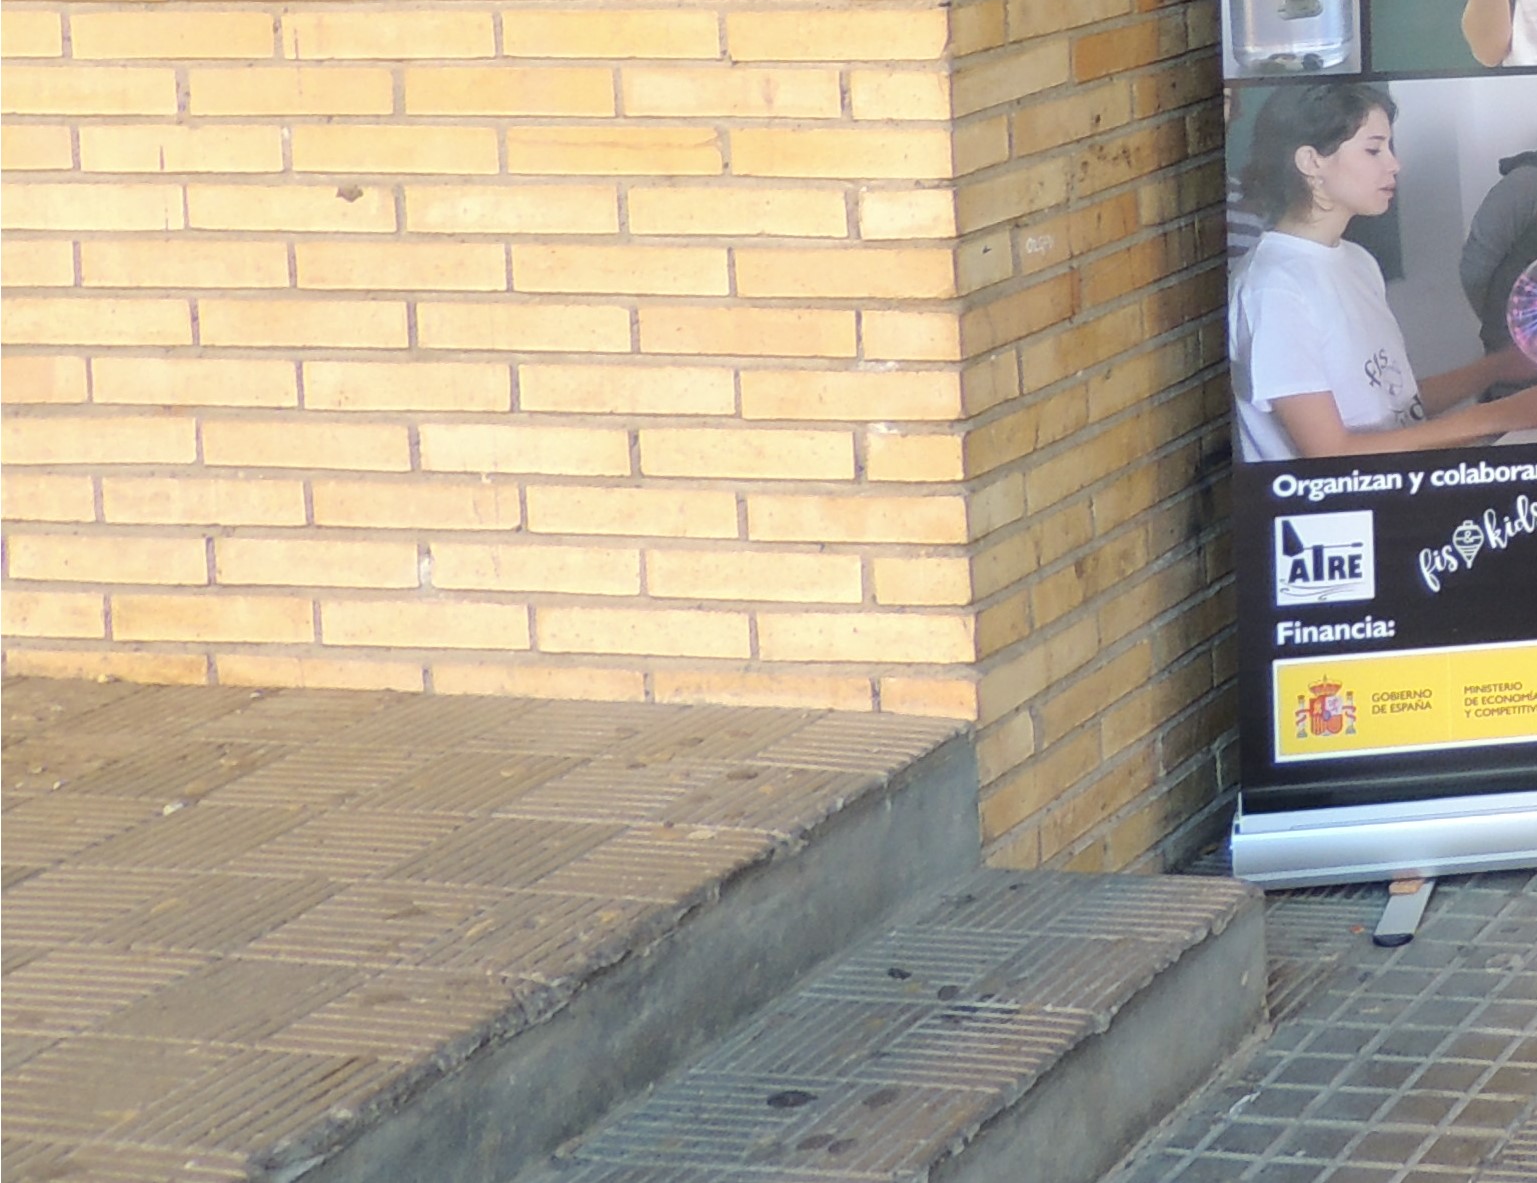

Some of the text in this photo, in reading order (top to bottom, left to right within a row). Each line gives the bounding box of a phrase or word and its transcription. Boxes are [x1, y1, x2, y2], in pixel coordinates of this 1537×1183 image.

[1272, 469, 1402, 501] Organizan
[1408, 471, 1425, 495] y
[1419, 544, 1458, 593] fis
[1276, 616, 1396, 645] Financia:
[1372, 688, 1433, 702] GOBIERNO
[1464, 682, 1523, 695] MINISTERIO
[1372, 700, 1433, 715] DE ESPAÑA
[1464, 696, 1479, 707] DE
[1465, 709, 1472, 718] Y
